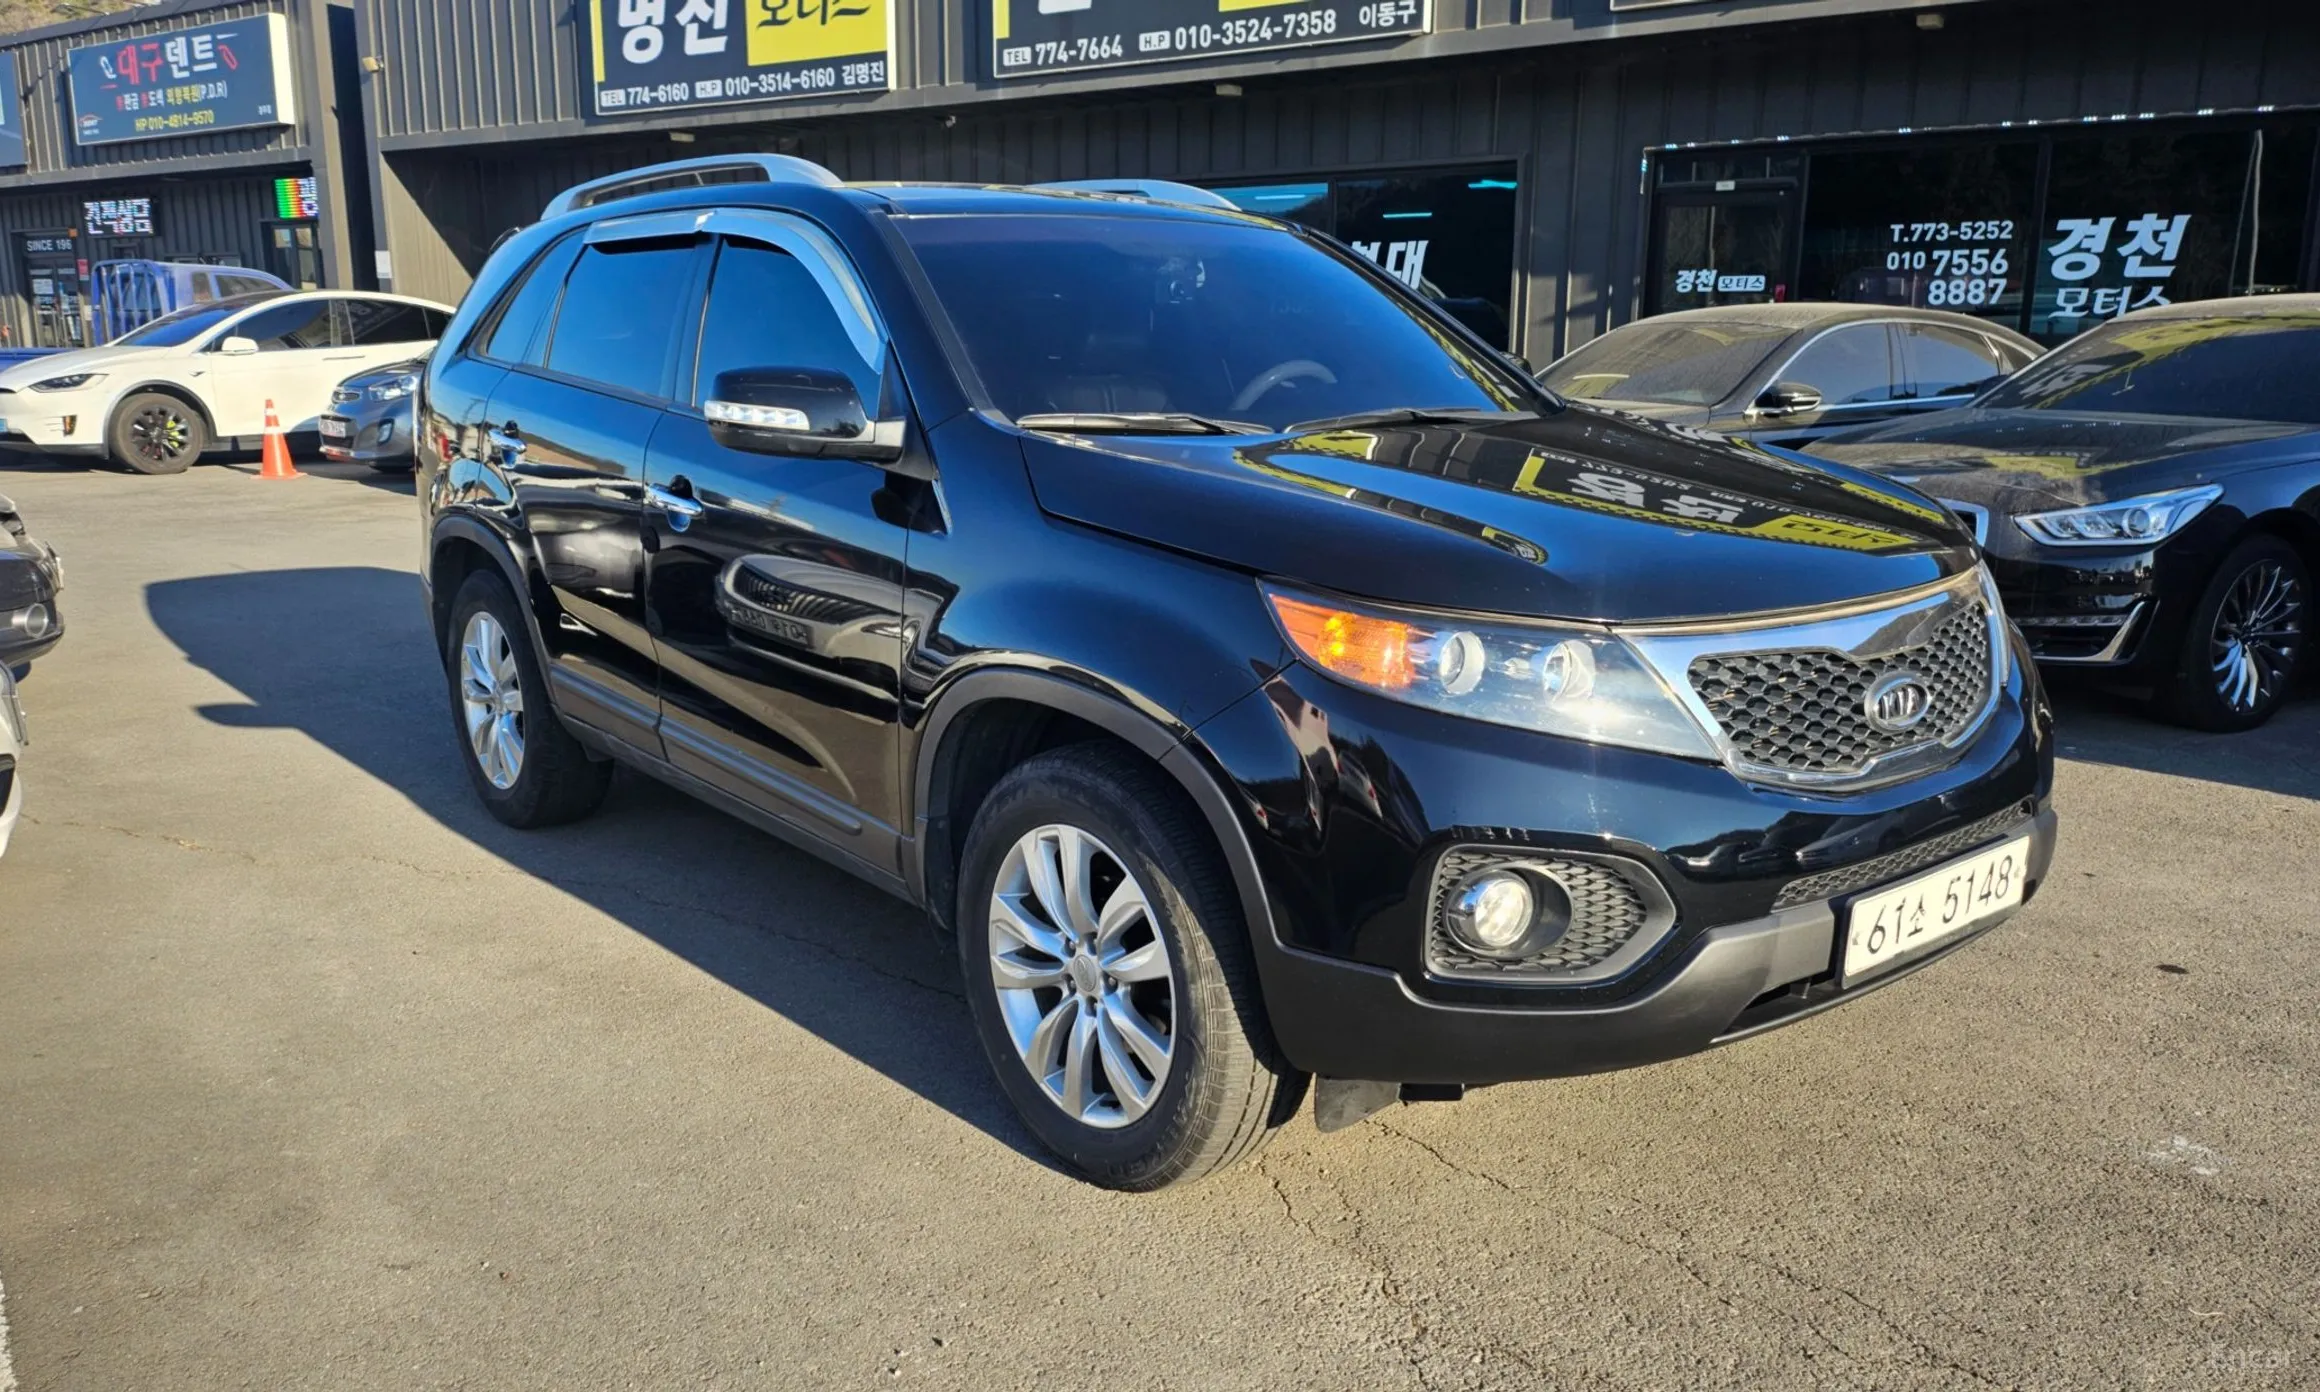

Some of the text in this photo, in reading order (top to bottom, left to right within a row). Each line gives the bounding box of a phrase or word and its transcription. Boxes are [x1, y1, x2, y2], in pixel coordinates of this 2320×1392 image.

[1007, 0, 1417, 66] TEL 774-7664 H.P 010-3524-7358 이동구
[602, 91, 623, 105] TEL
[627, 82, 689, 106] 774-6160
[725, 67, 835, 97] 010-3514-6160
[841, 60, 885, 85] 김명진
[26, 239, 53, 252] SINCE
[1890, 220, 2013, 243] T.773-5252
[2047, 212, 2193, 281] 경천
[1886, 248, 2009, 277] 010 7556
[1675, 268, 1764, 293] 경천 모터스
[1927, 278, 2008, 305] 8887
[2047, 285, 2173, 319] 모터스
[1941, 854, 2014, 925] 5148
